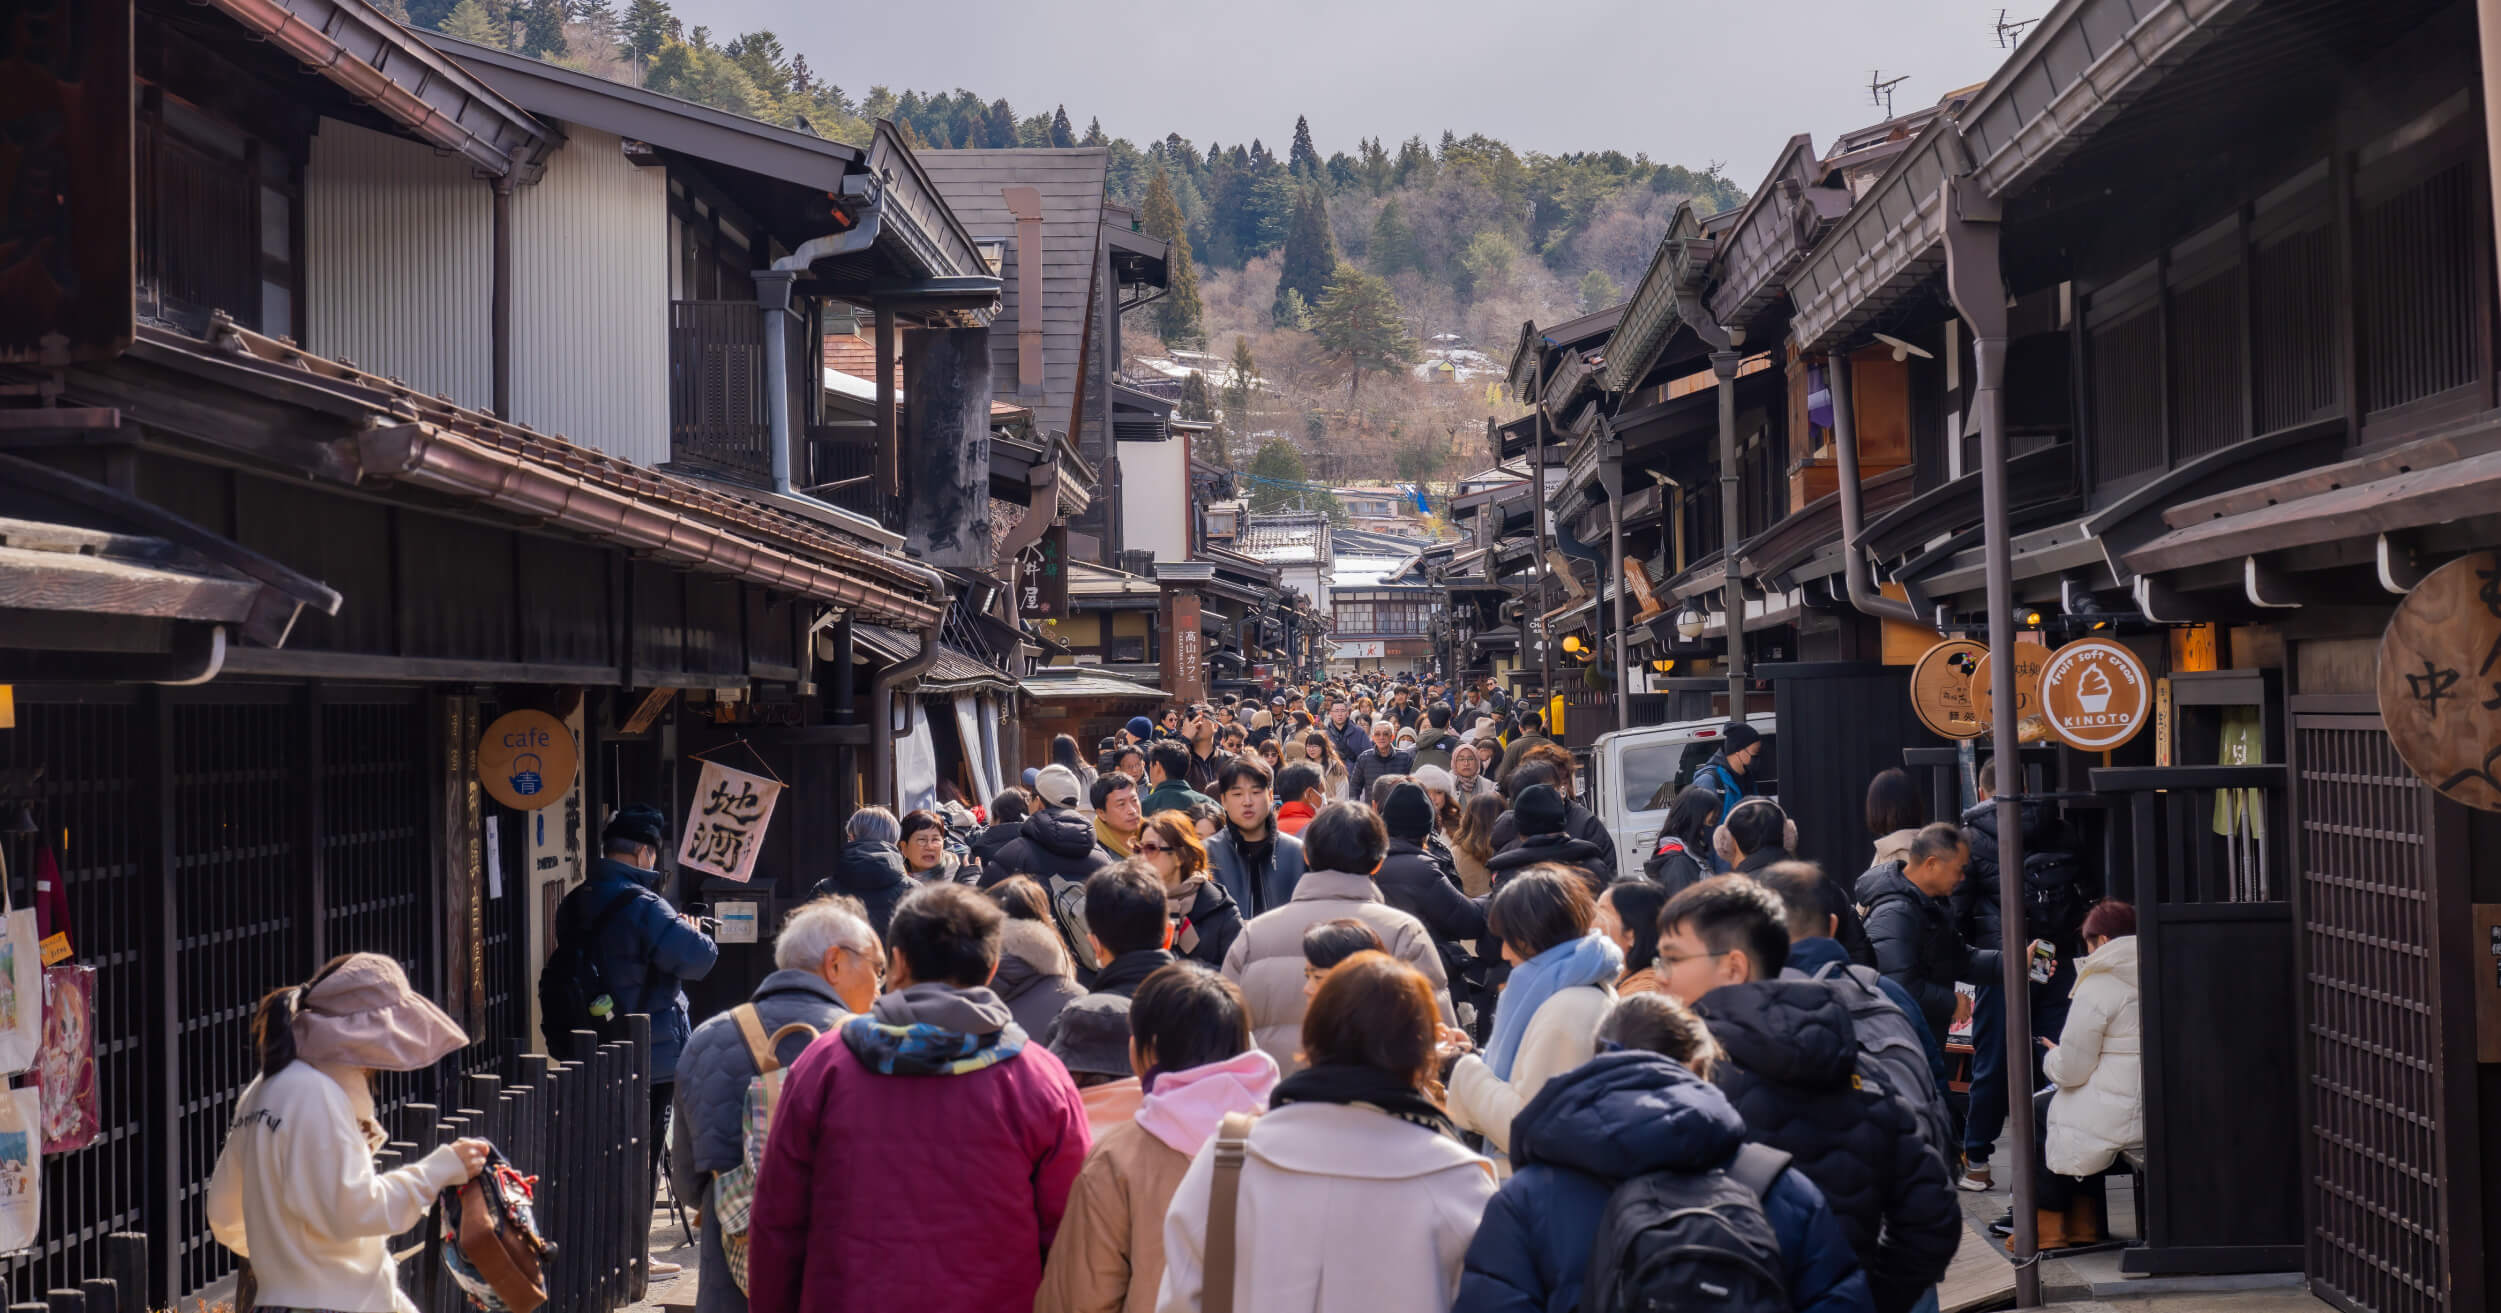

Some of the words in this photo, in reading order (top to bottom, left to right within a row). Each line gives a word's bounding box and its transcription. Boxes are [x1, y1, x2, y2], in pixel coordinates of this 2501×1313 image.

[1185, 631, 1197, 682] 高山カフェ
[2051, 659, 2075, 686] fruit
[2079, 650, 2104, 663] soft
[2108, 656, 2136, 685] cream
[2064, 713, 2129, 727] KINOTO
[504, 728, 550, 748] cafe
[516, 771, 539, 793] 青
[688, 781, 769, 873] 地酒
